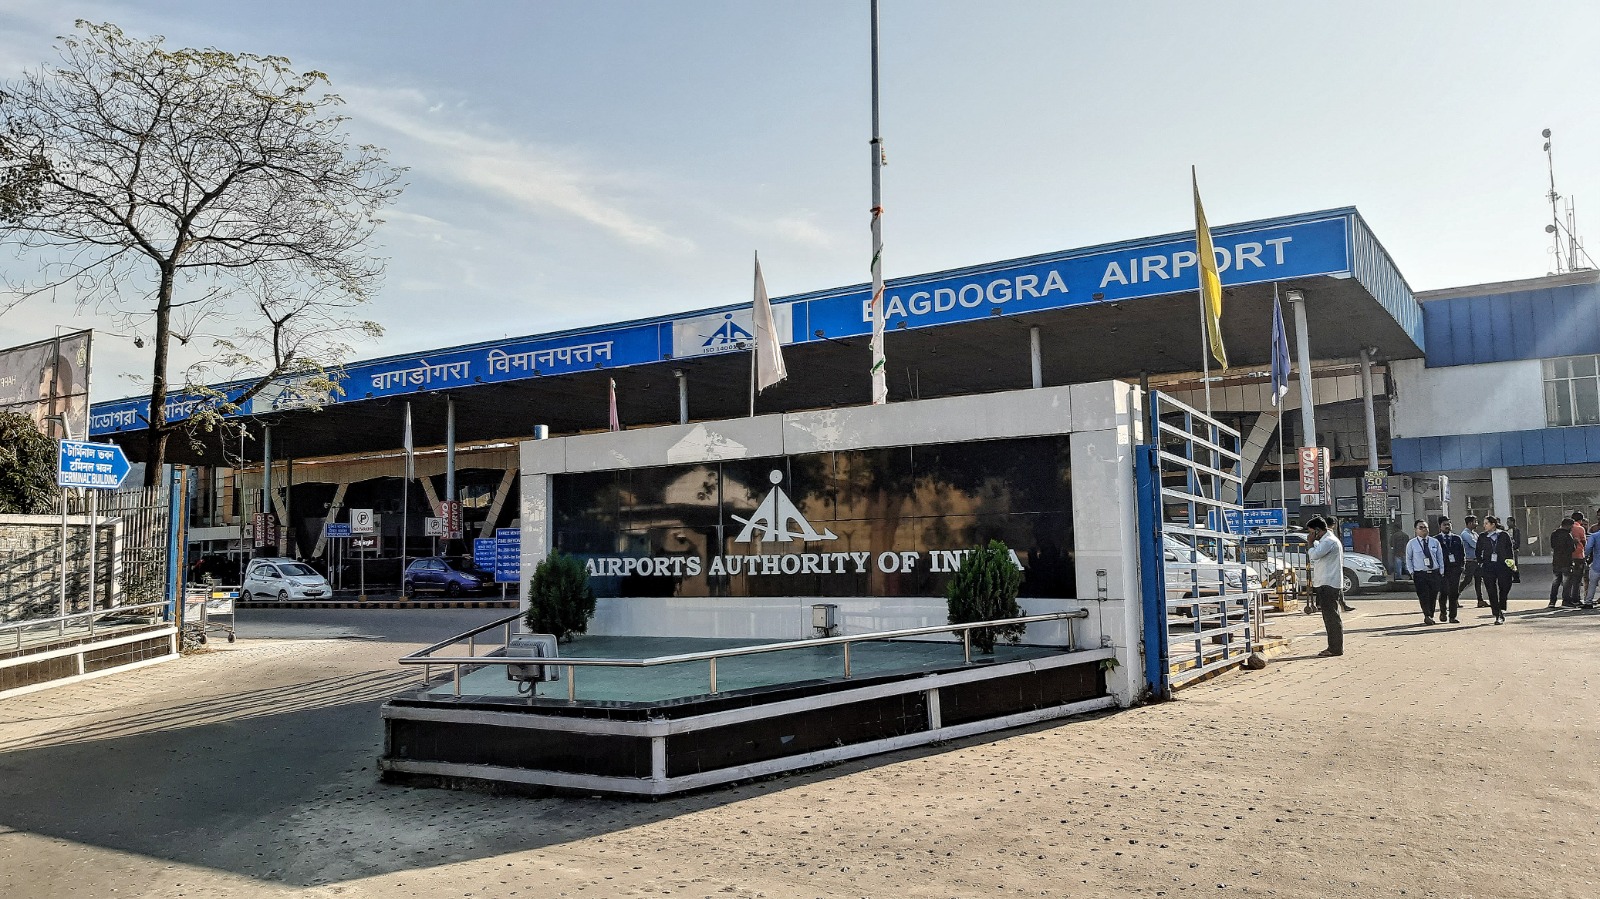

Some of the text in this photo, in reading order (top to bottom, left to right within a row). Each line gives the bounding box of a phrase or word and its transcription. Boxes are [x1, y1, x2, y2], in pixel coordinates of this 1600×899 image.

[862, 236, 1293, 323] BAGDOGRA AIRPORT
[371, 341, 614, 390] बागडोगरा विमानपत्तन
[61, 471, 118, 485] TERMINAL BUILDING
[1302, 450, 1315, 493] SERVO
[1368, 477, 1383, 486] 50
[267, 514, 275, 546] SERVO
[585, 548, 1025, 577] AIRPORTS AUTHORITY OF INA
